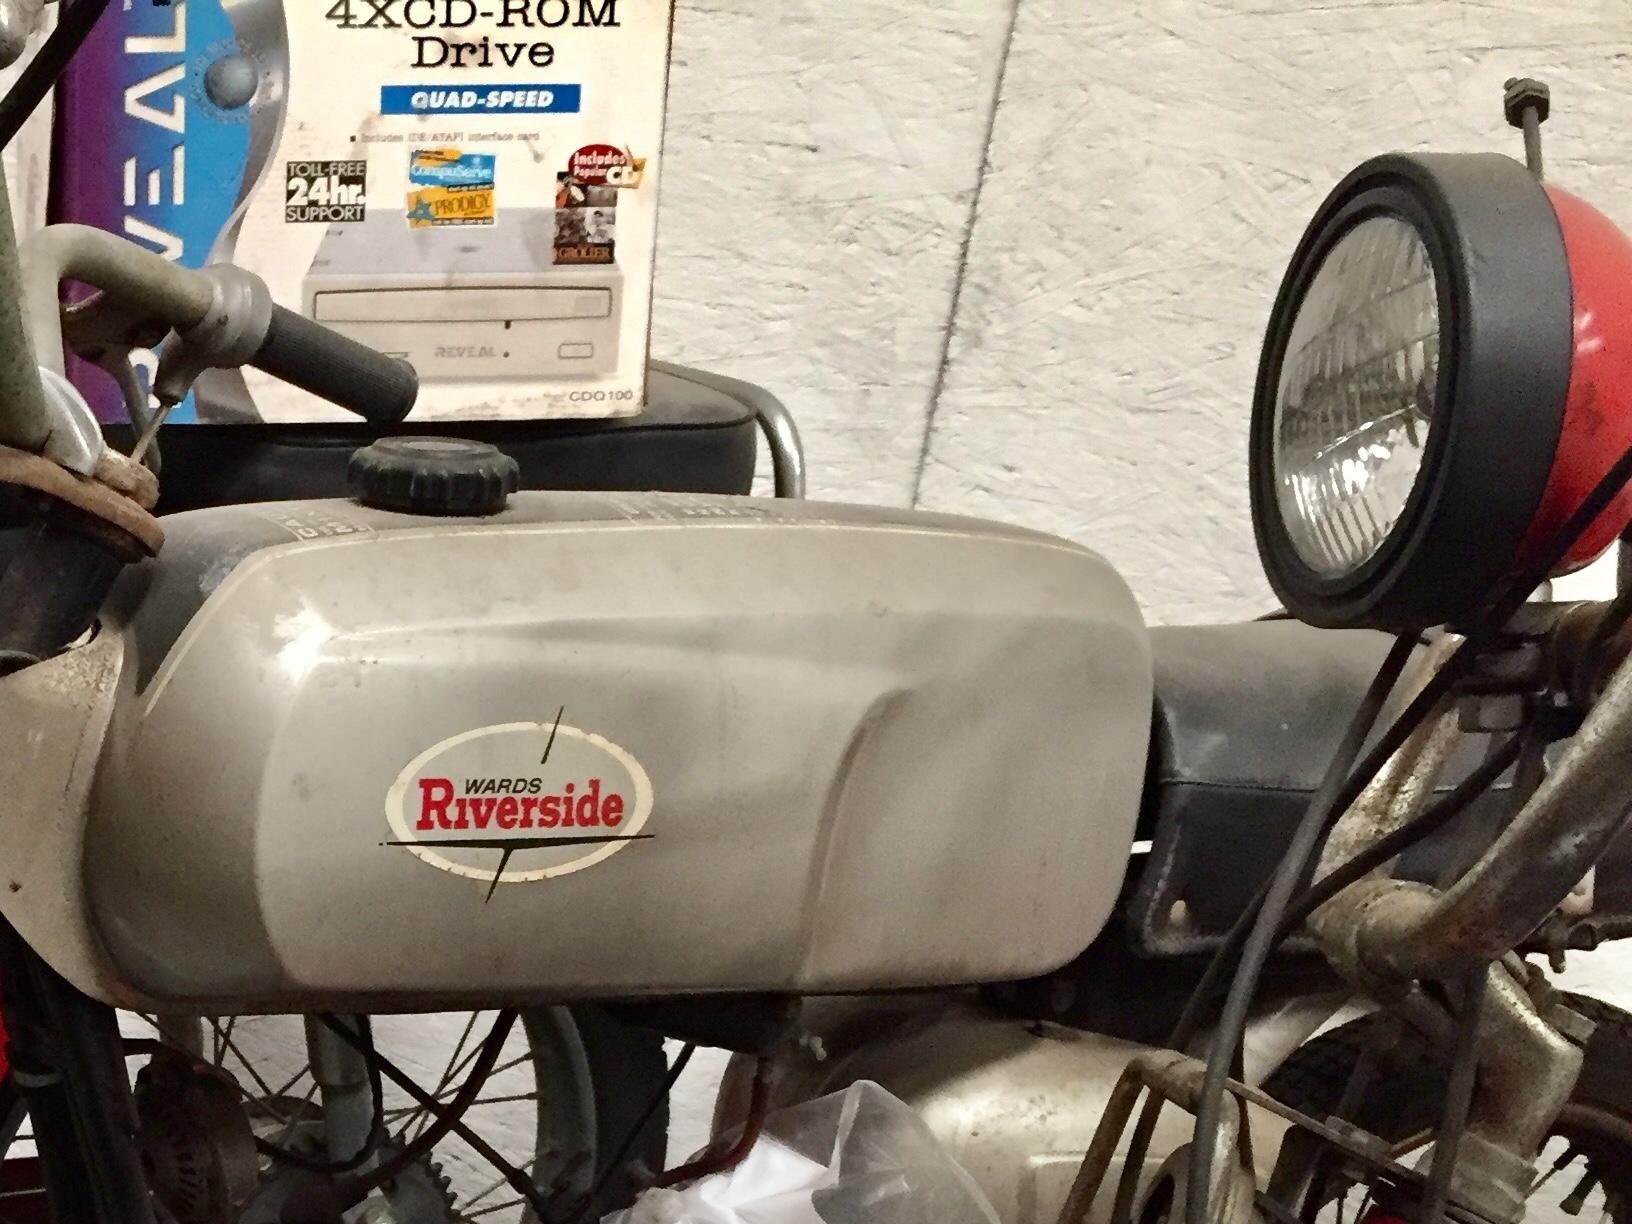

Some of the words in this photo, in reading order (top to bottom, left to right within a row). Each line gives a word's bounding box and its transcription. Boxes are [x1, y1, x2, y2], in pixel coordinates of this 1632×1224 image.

[411, 36, 555, 68] Drive
[411, 90, 555, 109] QUAD-SPEED
[573, 150, 626, 166] Includes
[287, 162, 365, 177] TOLL-FREE
[411, 164, 492, 180] CompuServe
[573, 165, 607, 179] Popular
[606, 165, 638, 185] CD
[286, 175, 367, 206] 24hr.
[435, 193, 491, 216] PRODIGY
[286, 206, 363, 222] SUPPORT
[434, 346, 497, 358] REVEAL
[569, 390, 634, 402] CDQ100
[465, 777, 543, 795] WARDS
[415, 778, 624, 831] Riverside
